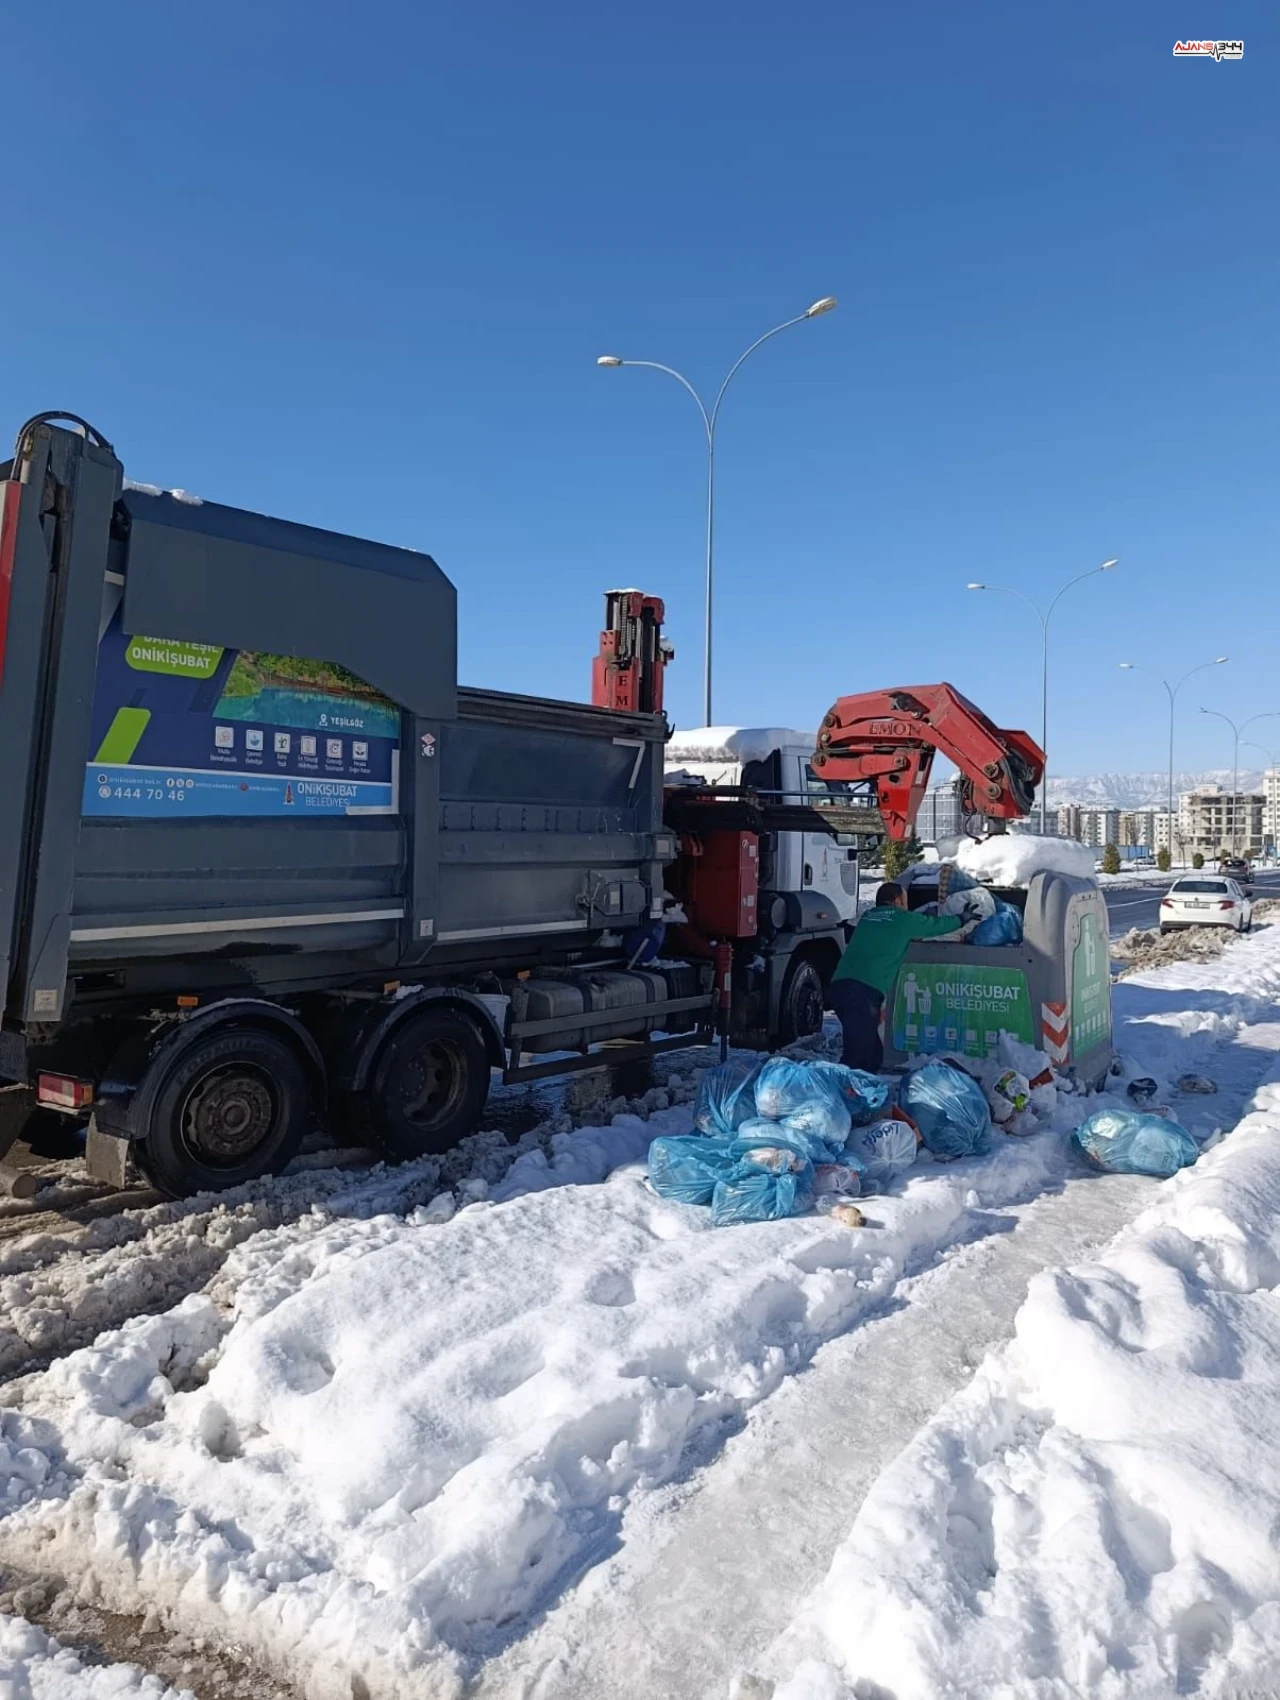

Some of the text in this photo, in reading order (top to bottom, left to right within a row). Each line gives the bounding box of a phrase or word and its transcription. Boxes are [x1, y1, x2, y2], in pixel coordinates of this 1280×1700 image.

[132, 646, 211, 669] ONİKİŞUBAT
[114, 787, 185, 801] 444 70 46
[297, 782, 358, 798] ONİKİŞUBAT
[935, 982, 1021, 1000] ONİKİŞUBAT
[946, 1000, 1010, 1013] BELEDİYESİ
